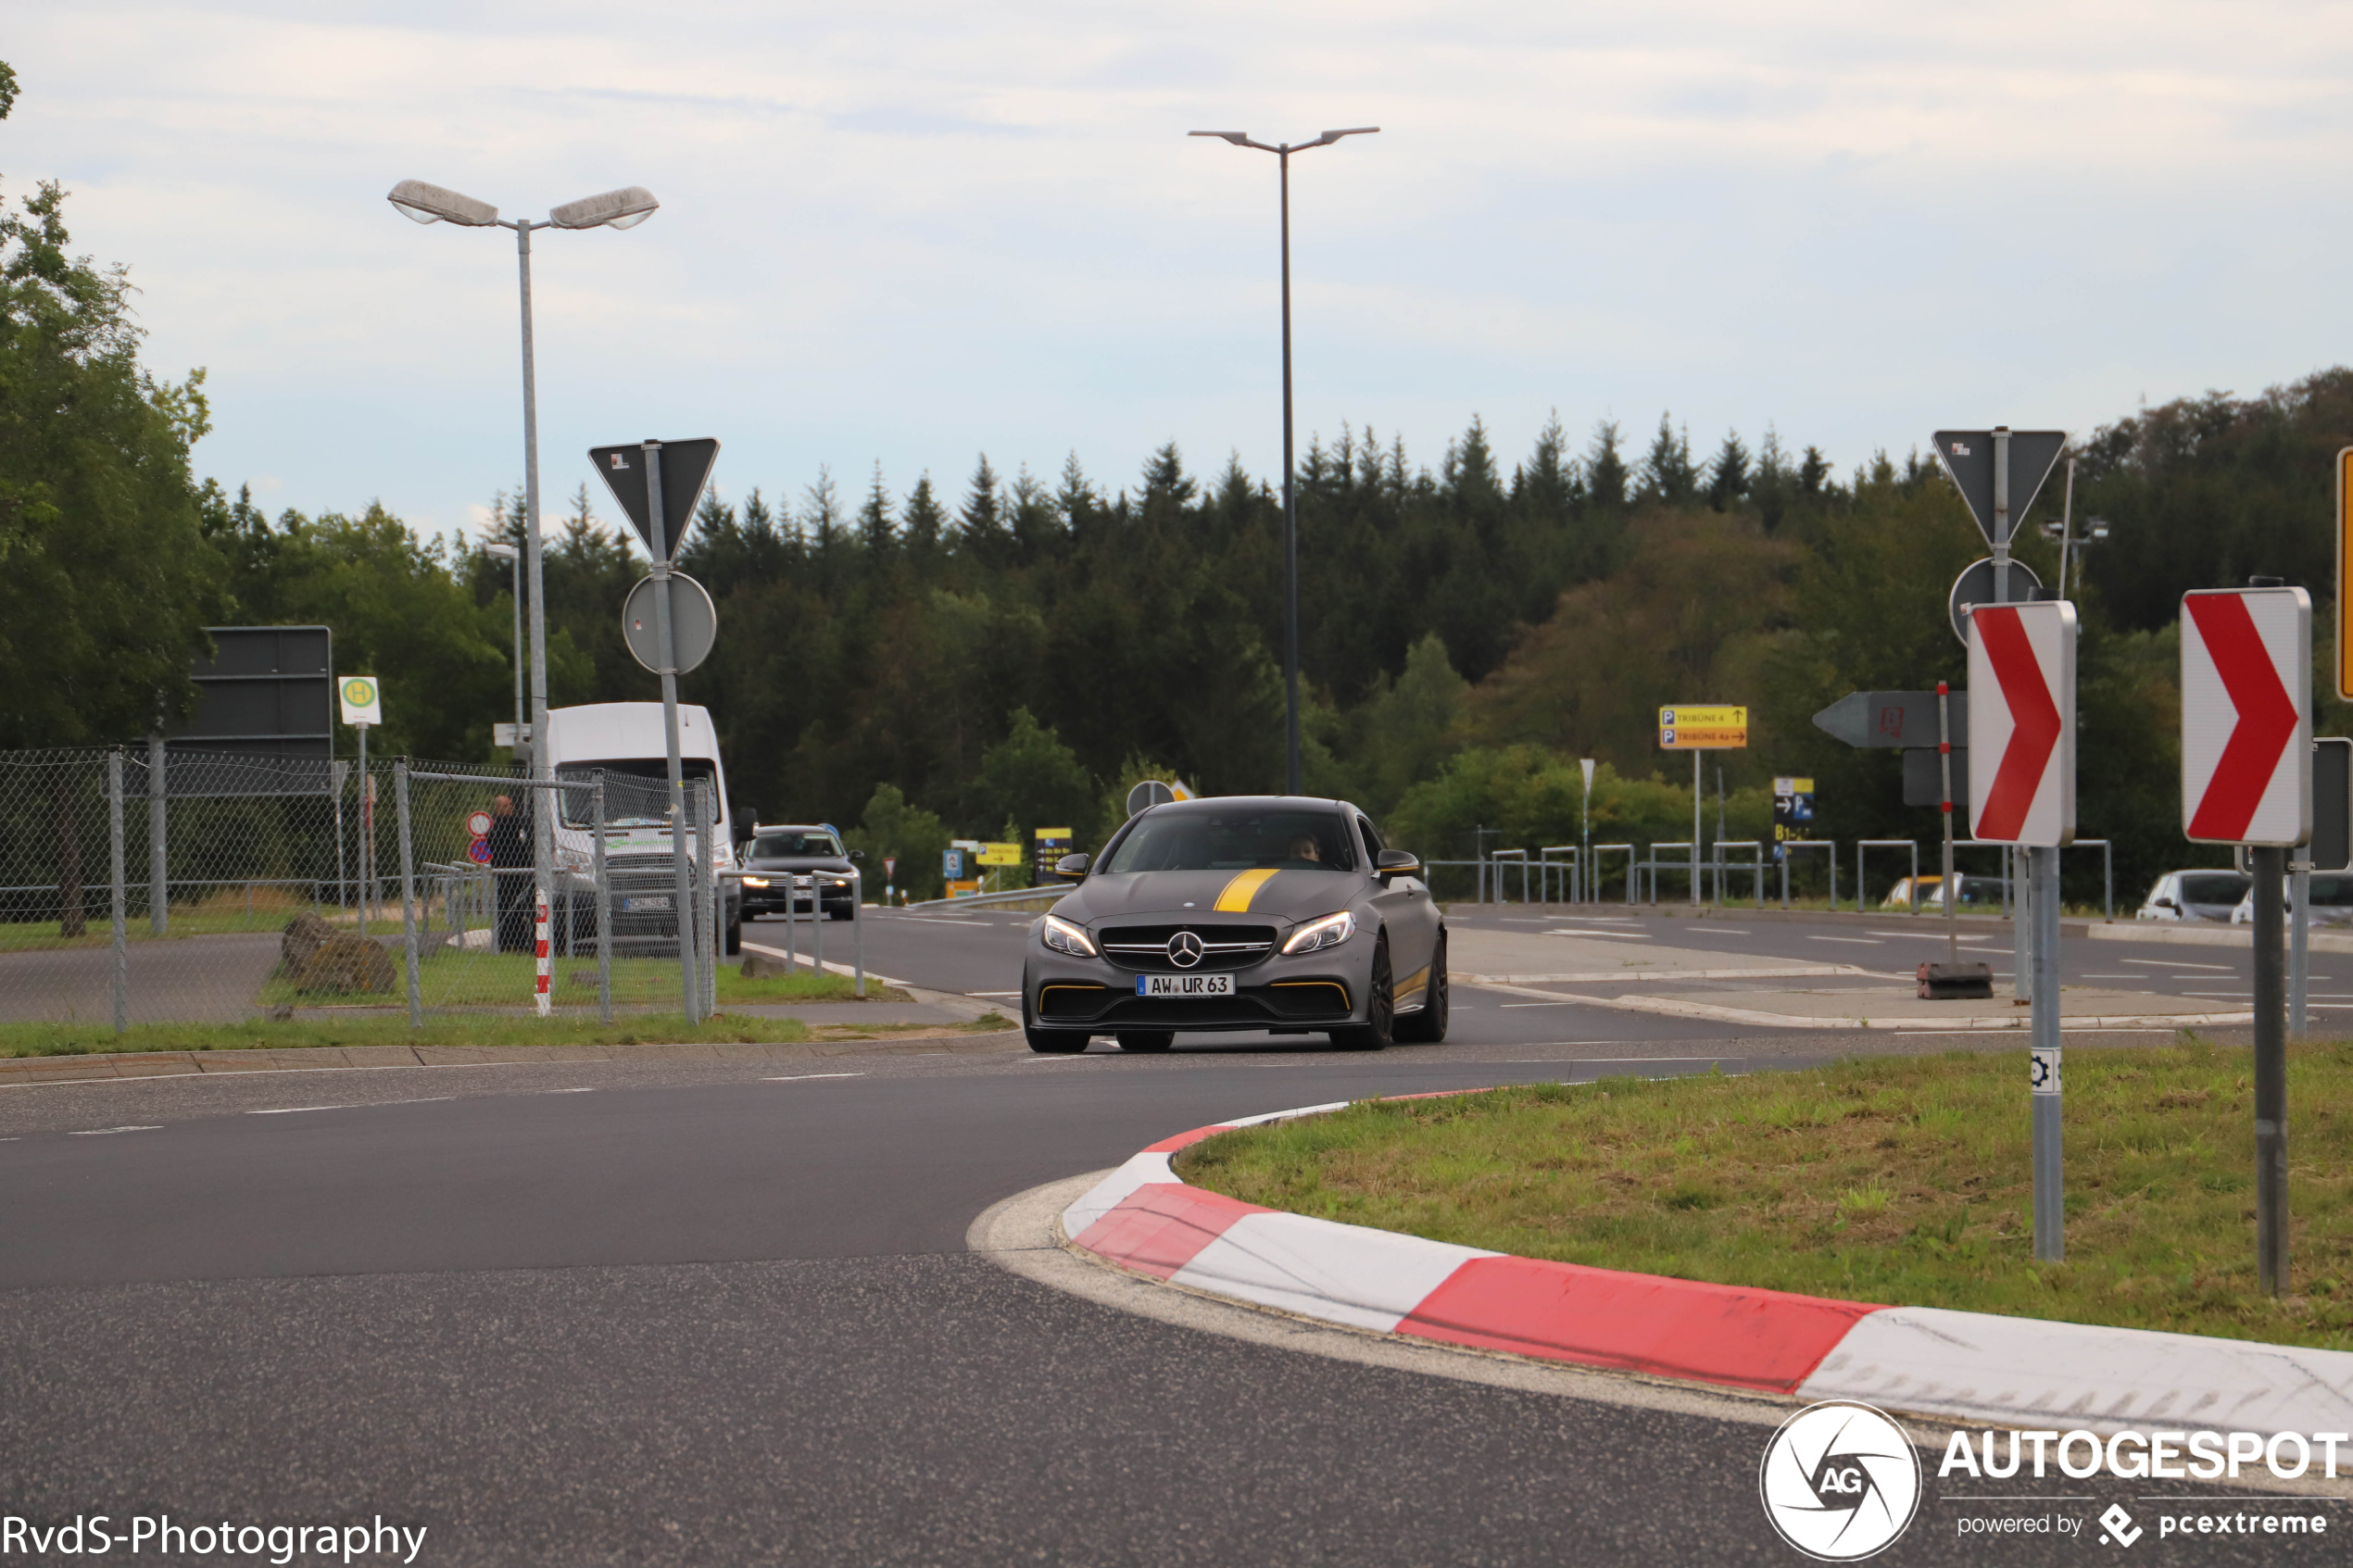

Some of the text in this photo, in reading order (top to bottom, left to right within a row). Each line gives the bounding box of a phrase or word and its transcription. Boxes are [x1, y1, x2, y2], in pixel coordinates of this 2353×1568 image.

[351, 685, 366, 700] H
[1678, 712, 1717, 722] TRIBÜNE
[1678, 731, 1717, 741] TRIBÜNE
[1151, 978, 1172, 993] AW
[1183, 977, 1203, 993] UR
[1207, 977, 1227, 993] 63
